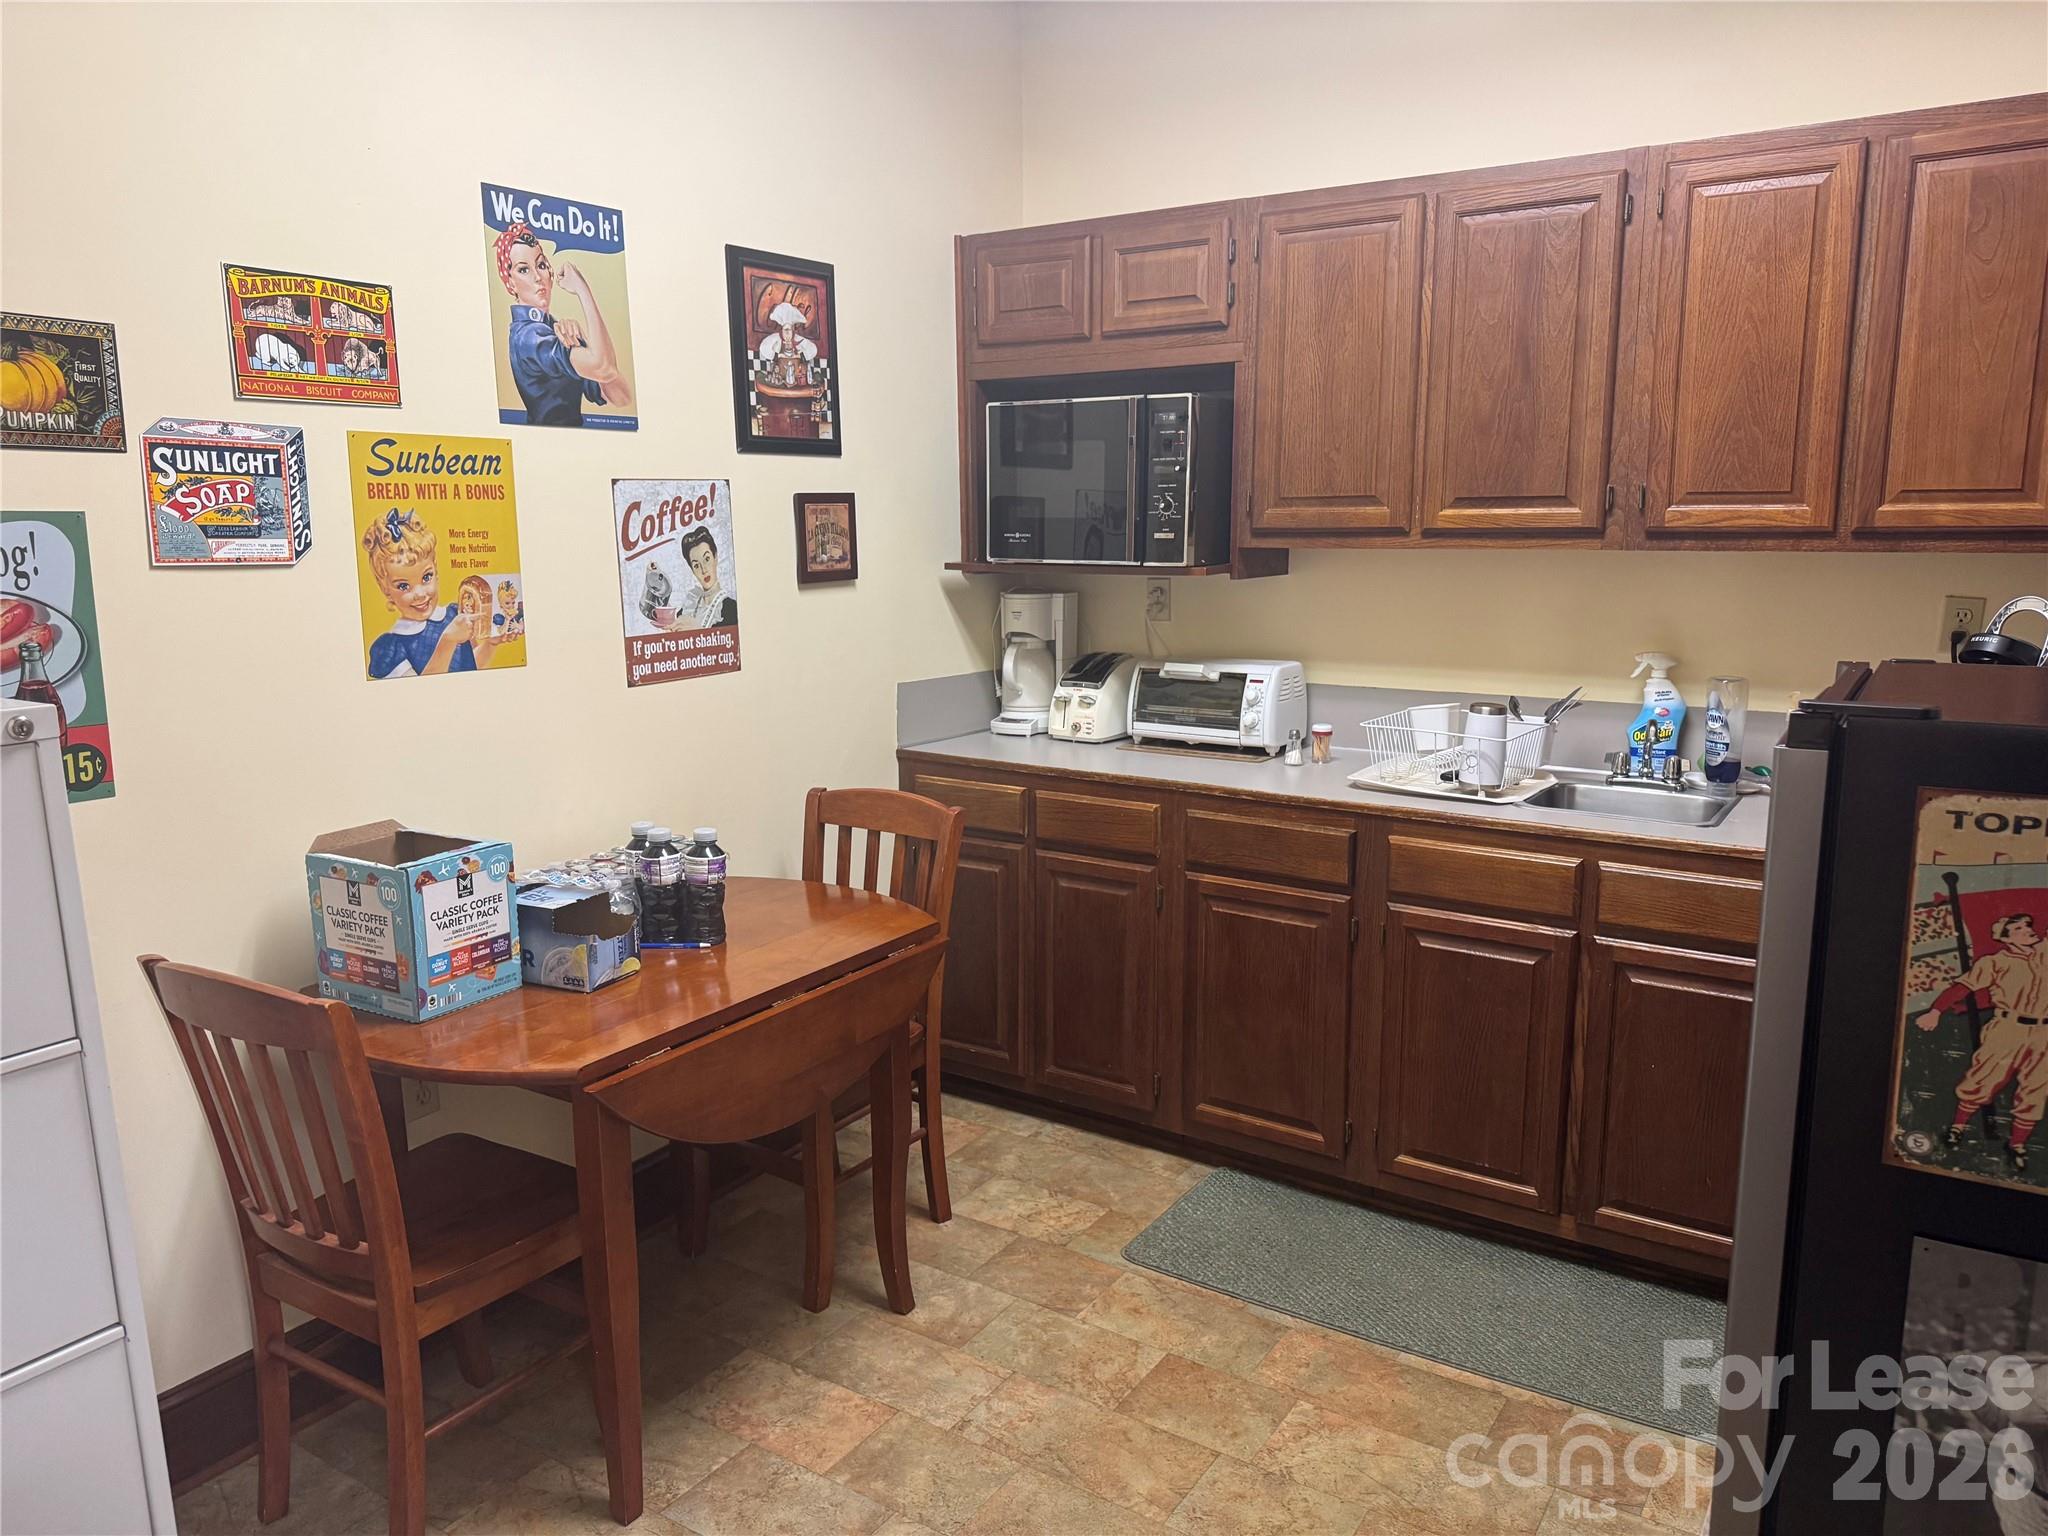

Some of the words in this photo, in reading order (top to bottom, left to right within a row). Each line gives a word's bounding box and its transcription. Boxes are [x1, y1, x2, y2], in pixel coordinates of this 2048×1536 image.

[490, 190, 524, 223] We
[527, 199, 565, 232] Can
[568, 206, 595, 237] Do
[598, 212, 619, 242] It!
[238, 277, 316, 295] BARNUM'S
[320, 284, 385, 311] ANIMALS
[75, 361, 96, 372] FIRST
[74, 373, 101, 387] QUALITY
[243, 382, 298, 394] NATIONAL
[306, 386, 342, 396] BISCUIT
[352, 390, 396, 400] COMPANY
[152, 446, 280, 486] SUNLIGHT
[367, 438, 502, 477] Sunbeam
[174, 484, 250, 516] SOAP
[287, 445, 311, 551] SUNLIGHT
[367, 482, 409, 499] BREAD
[415, 483, 447, 500] WITH
[453, 484, 461, 500] A
[466, 484, 505, 500] BONUS
[621, 482, 716, 551] Coffee!
[449, 529, 465, 538] More
[468, 529, 489, 540] Energy
[450, 544, 466, 553] More
[468, 544, 496, 553] Nutrition
[451, 559, 467, 569] More
[470, 559, 488, 568] Flavor
[633, 640, 642, 656] If
[644, 638, 676, 659] you're
[678, 637, 694, 650] not
[695, 631, 734, 649] shaking,
[633, 663, 651, 680] you
[654, 657, 678, 673] need
[680, 653, 717, 670] another
[718, 652, 736, 666] cup.
[63, 751, 104, 784] 15¢
[1945, 810, 2048, 837] TOP
[491, 862, 505, 875] 100
[381, 886, 397, 902] 100
[430, 903, 468, 921] CLASSIC
[470, 893, 503, 910] COFFEE
[326, 905, 357, 920] CLASSIC
[359, 912, 388, 926] COFFEE
[331, 917, 363, 933] VARIETY
[365, 924, 385, 938] PACK
[436, 912, 475, 931] VARIETY
[477, 905, 499, 920] PACK
